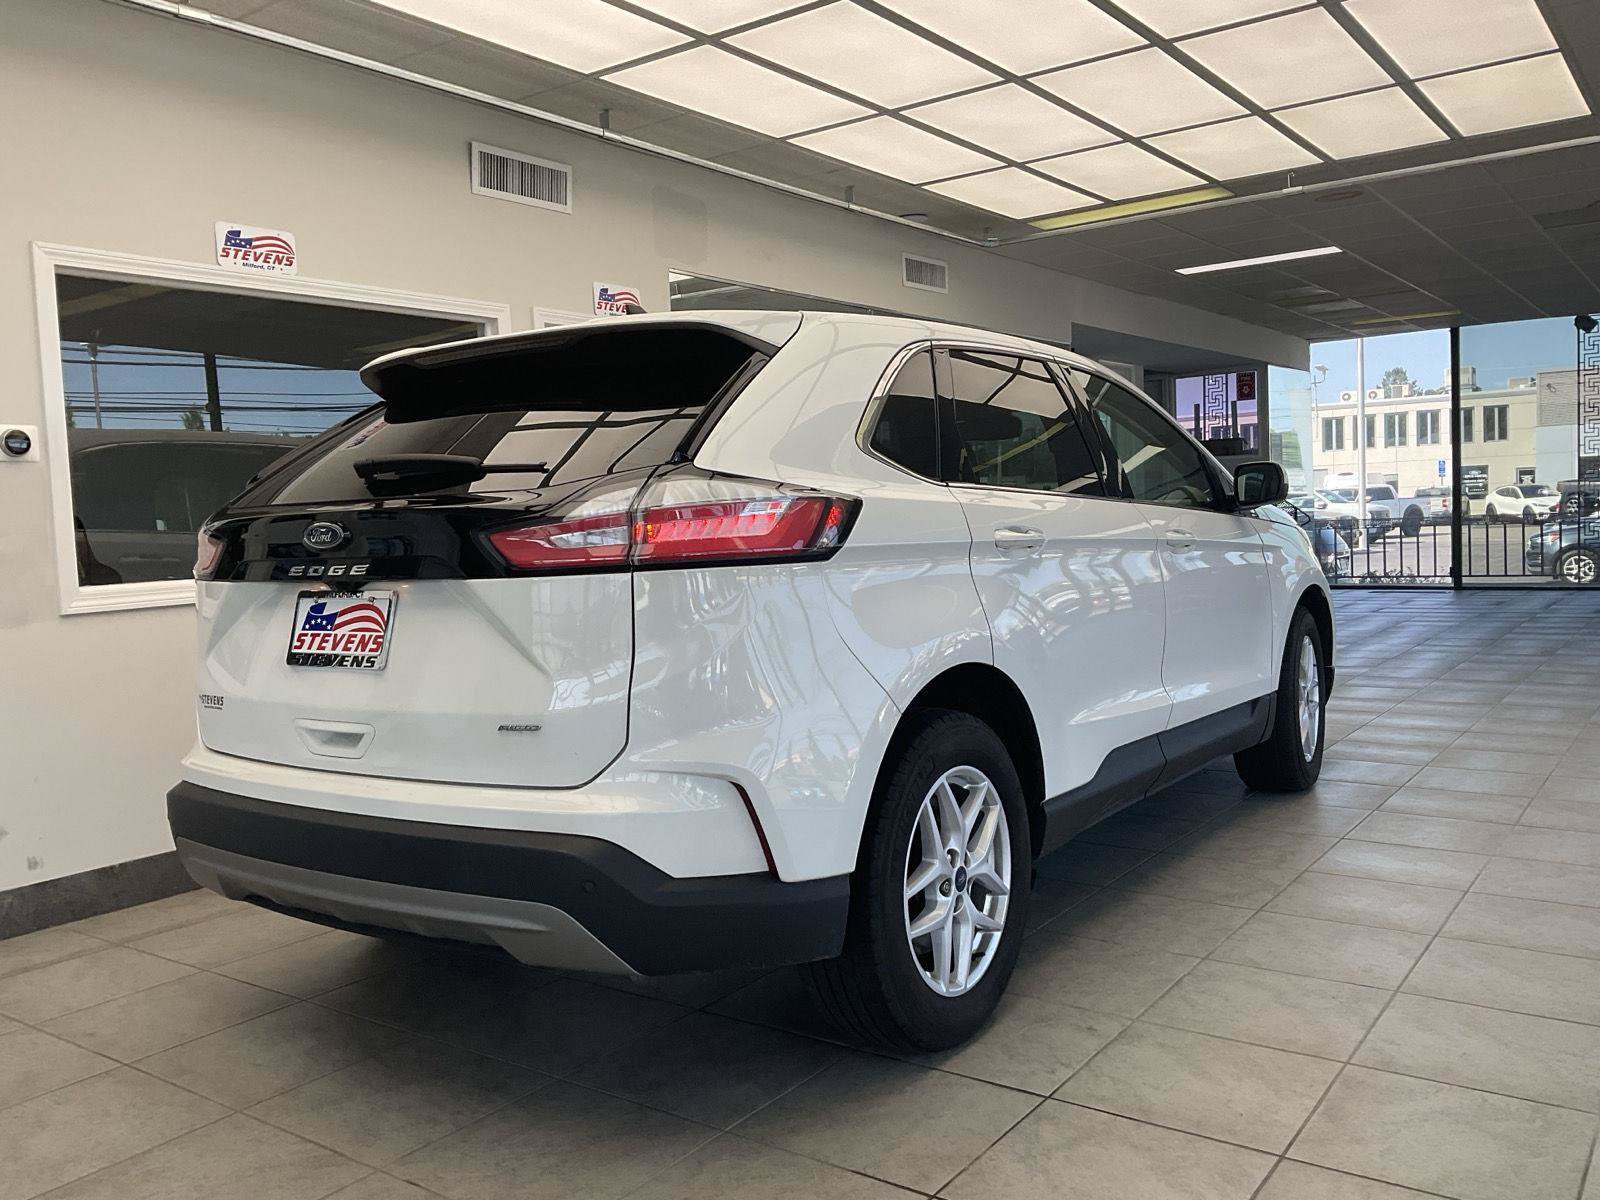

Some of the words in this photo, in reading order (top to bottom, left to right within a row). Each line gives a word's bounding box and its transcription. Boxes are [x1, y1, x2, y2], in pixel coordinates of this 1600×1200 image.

[220, 247, 295, 267] STEVENS
[311, 528, 331, 542] Ford
[288, 564, 370, 576] EDGE
[293, 632, 384, 653] STEVENS
[201, 694, 224, 706] STEVENS
